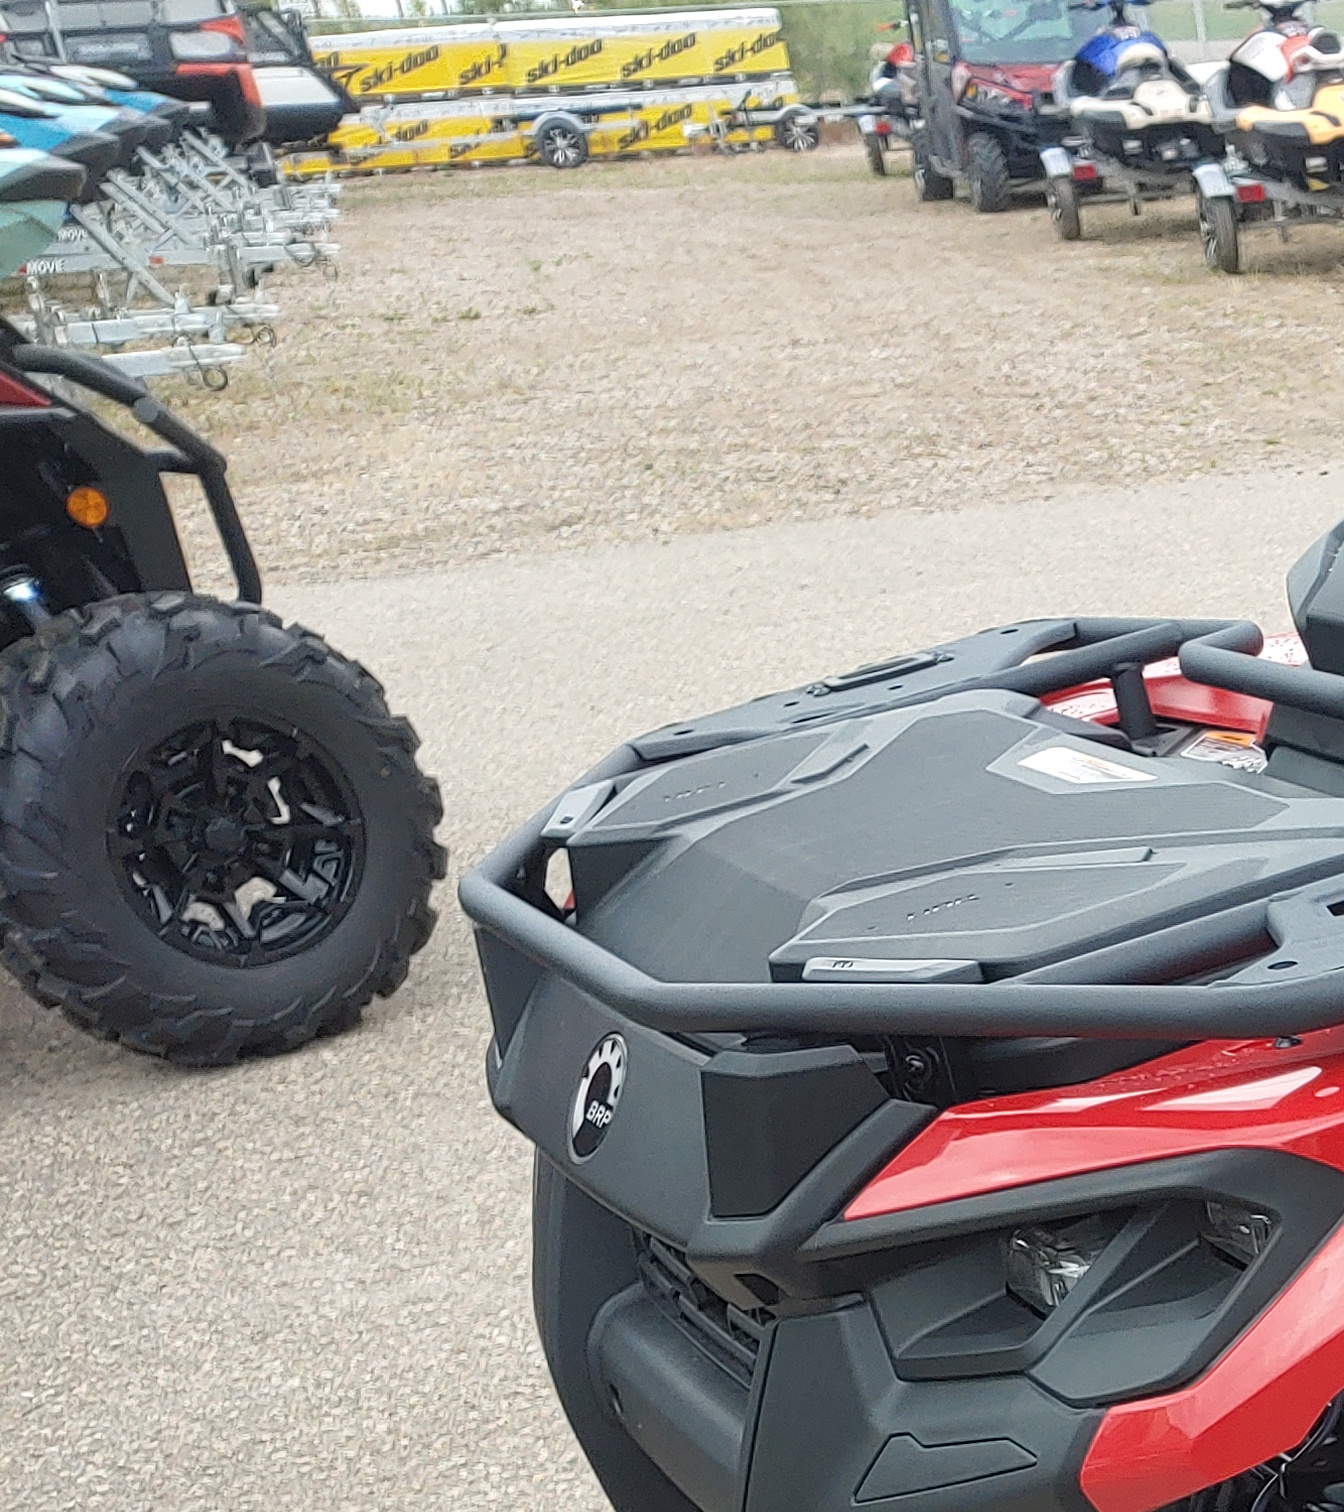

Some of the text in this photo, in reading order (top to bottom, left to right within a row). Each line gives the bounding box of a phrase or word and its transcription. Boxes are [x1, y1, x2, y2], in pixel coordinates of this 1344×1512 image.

[527, 38, 603, 84] ski-doo
[621, 32, 696, 78] ski-doo
[585, 1099, 613, 1129] BRP
